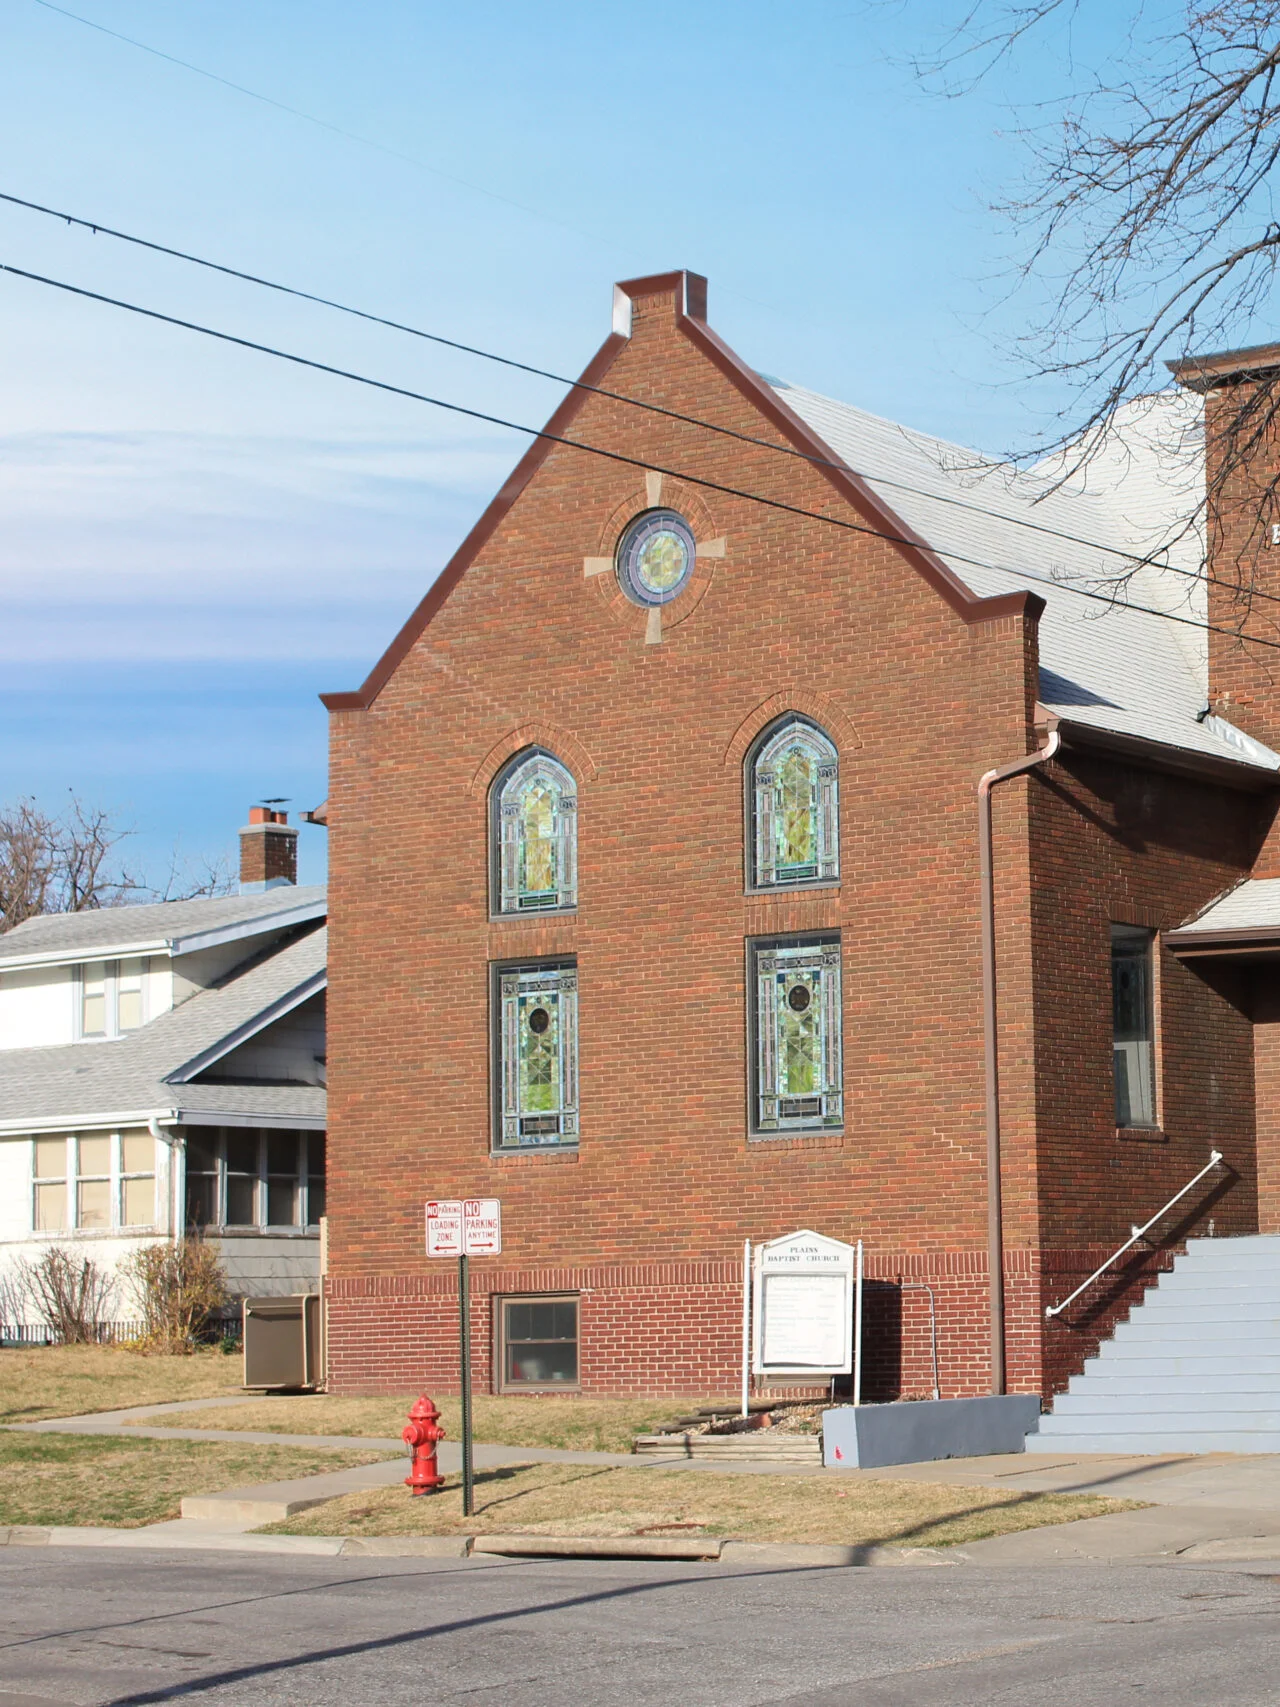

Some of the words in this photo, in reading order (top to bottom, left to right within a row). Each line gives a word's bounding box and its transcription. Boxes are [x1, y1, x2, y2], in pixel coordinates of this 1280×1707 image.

[427, 1205, 438, 1216] NO
[438, 1206, 461, 1214] PARKING
[465, 1202, 479, 1216] NO
[431, 1220, 459, 1230] LOADING
[466, 1218, 498, 1229] PARKING
[436, 1232, 453, 1242] ZONE
[468, 1231, 496, 1239] ANYTIME
